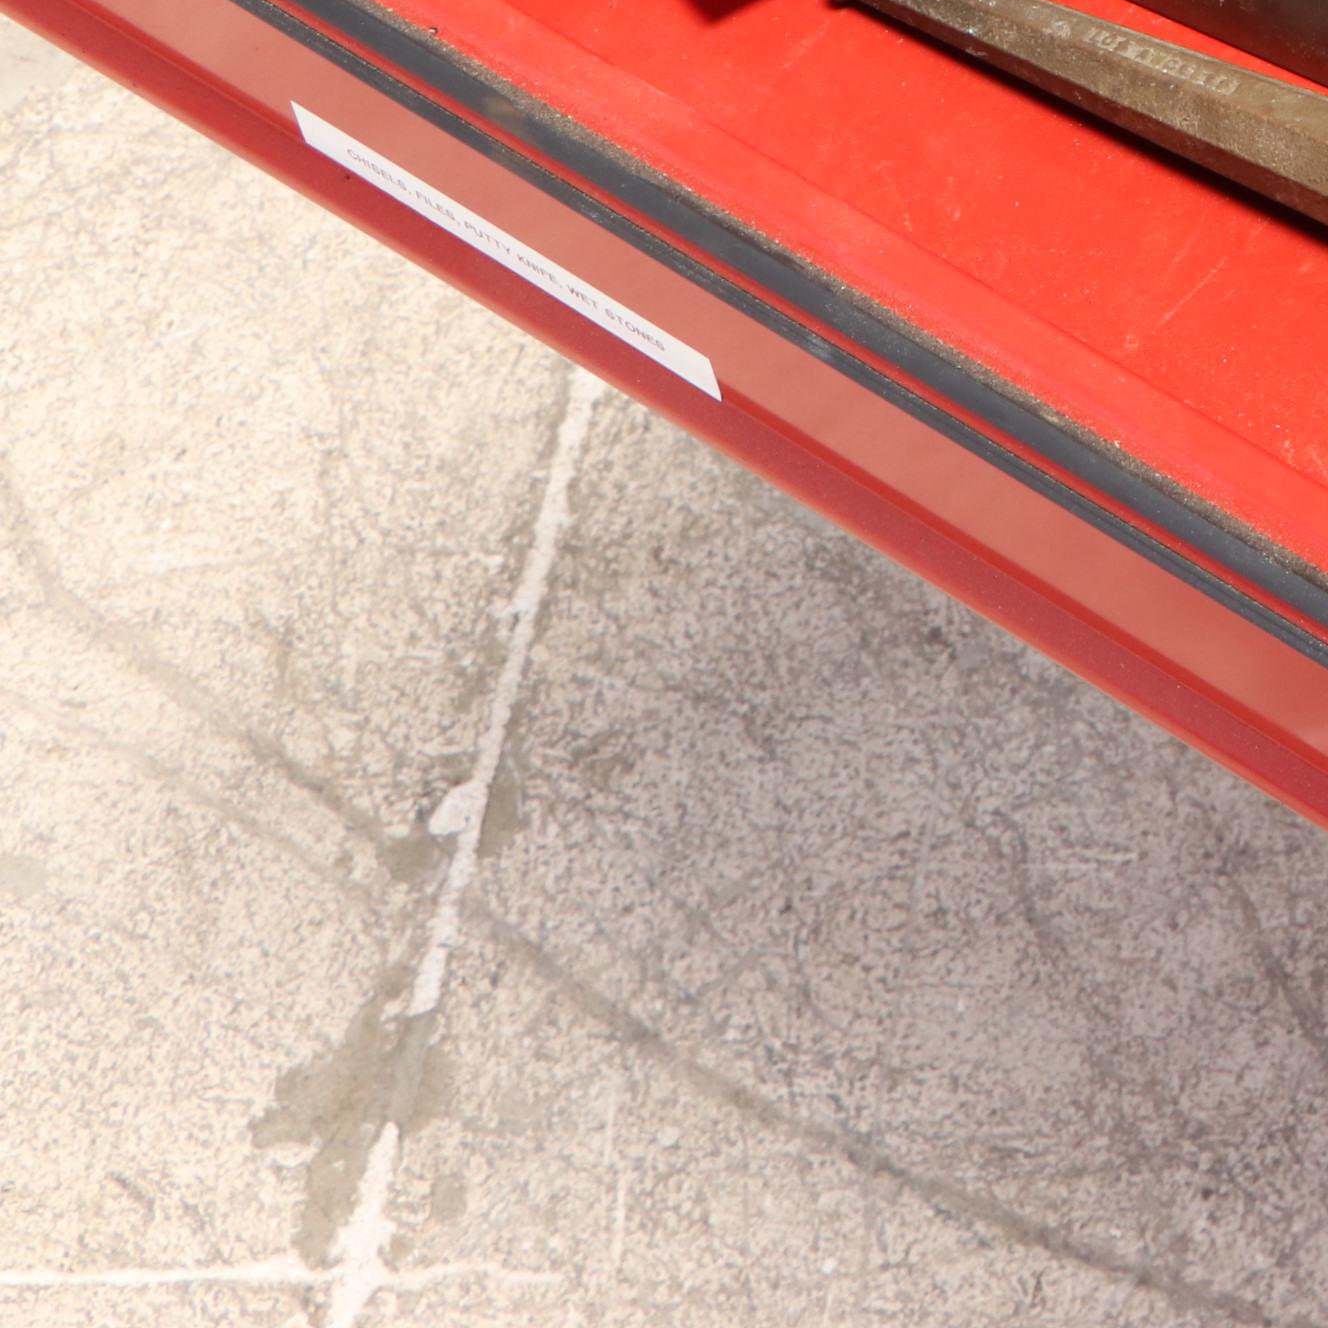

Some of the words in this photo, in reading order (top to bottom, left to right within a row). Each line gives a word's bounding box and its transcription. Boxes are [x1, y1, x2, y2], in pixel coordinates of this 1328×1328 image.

[346, 148, 412, 196] CHISELS,
[415, 190, 461, 226] FILES,
[463, 220, 511, 255] PUTTY
[516, 252, 563, 289] KNIFE,
[567, 283, 599, 309] WET
[604, 307, 666, 352] STONES
